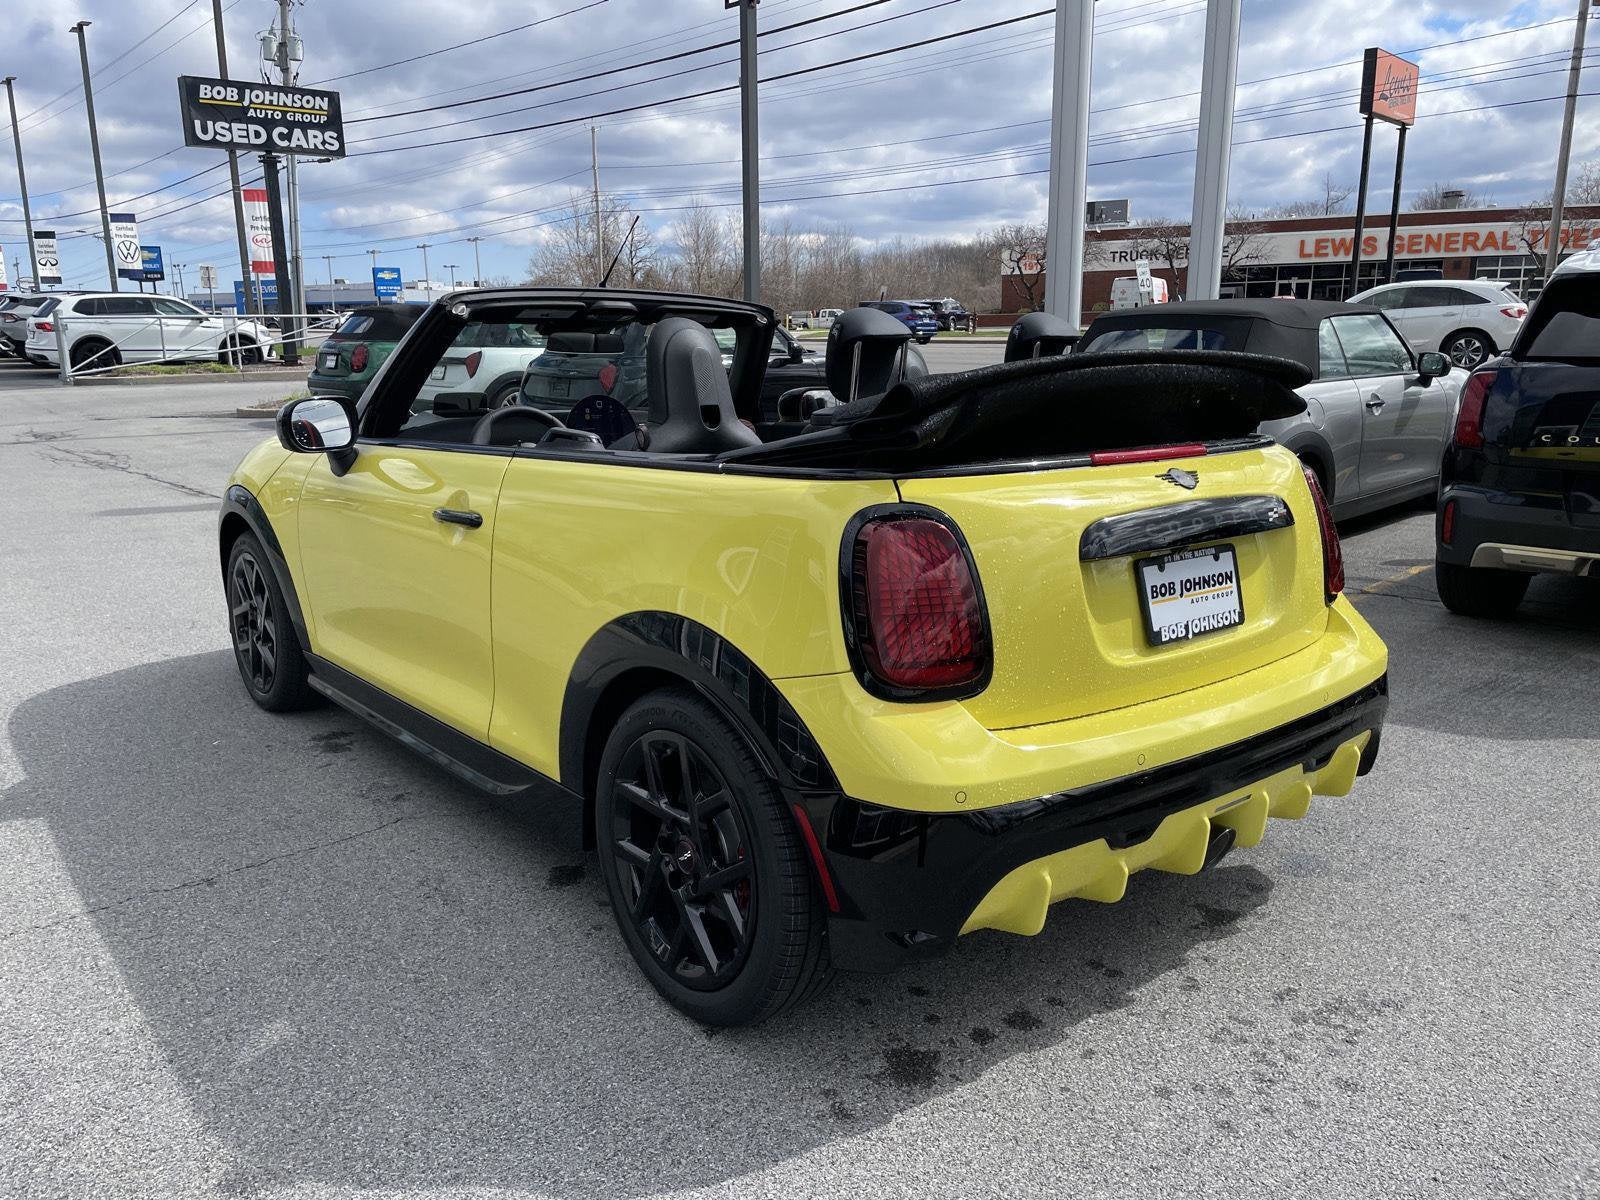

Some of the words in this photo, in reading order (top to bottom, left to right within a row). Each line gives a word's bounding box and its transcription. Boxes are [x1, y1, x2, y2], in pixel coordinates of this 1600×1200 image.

[199, 84, 239, 101] BOB
[241, 88, 328, 110] JOHNSON
[247, 109, 281, 119] AUTO
[286, 112, 328, 123] GROUP
[194, 119, 267, 145] USED
[272, 126, 340, 151] CARS
[1299, 235, 1378, 259] LEWS
[1387, 230, 1517, 255] GENERAL
[1140, 278, 1151, 288] 40
[1173, 553, 1181, 561] IN
[1181, 551, 1193, 560] THE
[1194, 547, 1216, 559] NATION
[1150, 581, 1177, 600] BOB
[1179, 570, 1233, 598] JOHNSON
[1190, 596, 1209, 604] AUTO
[1212, 590, 1234, 600] GROUP
[1161, 622, 1186, 642] BOB
[1186, 608, 1241, 639] JOHNSON
